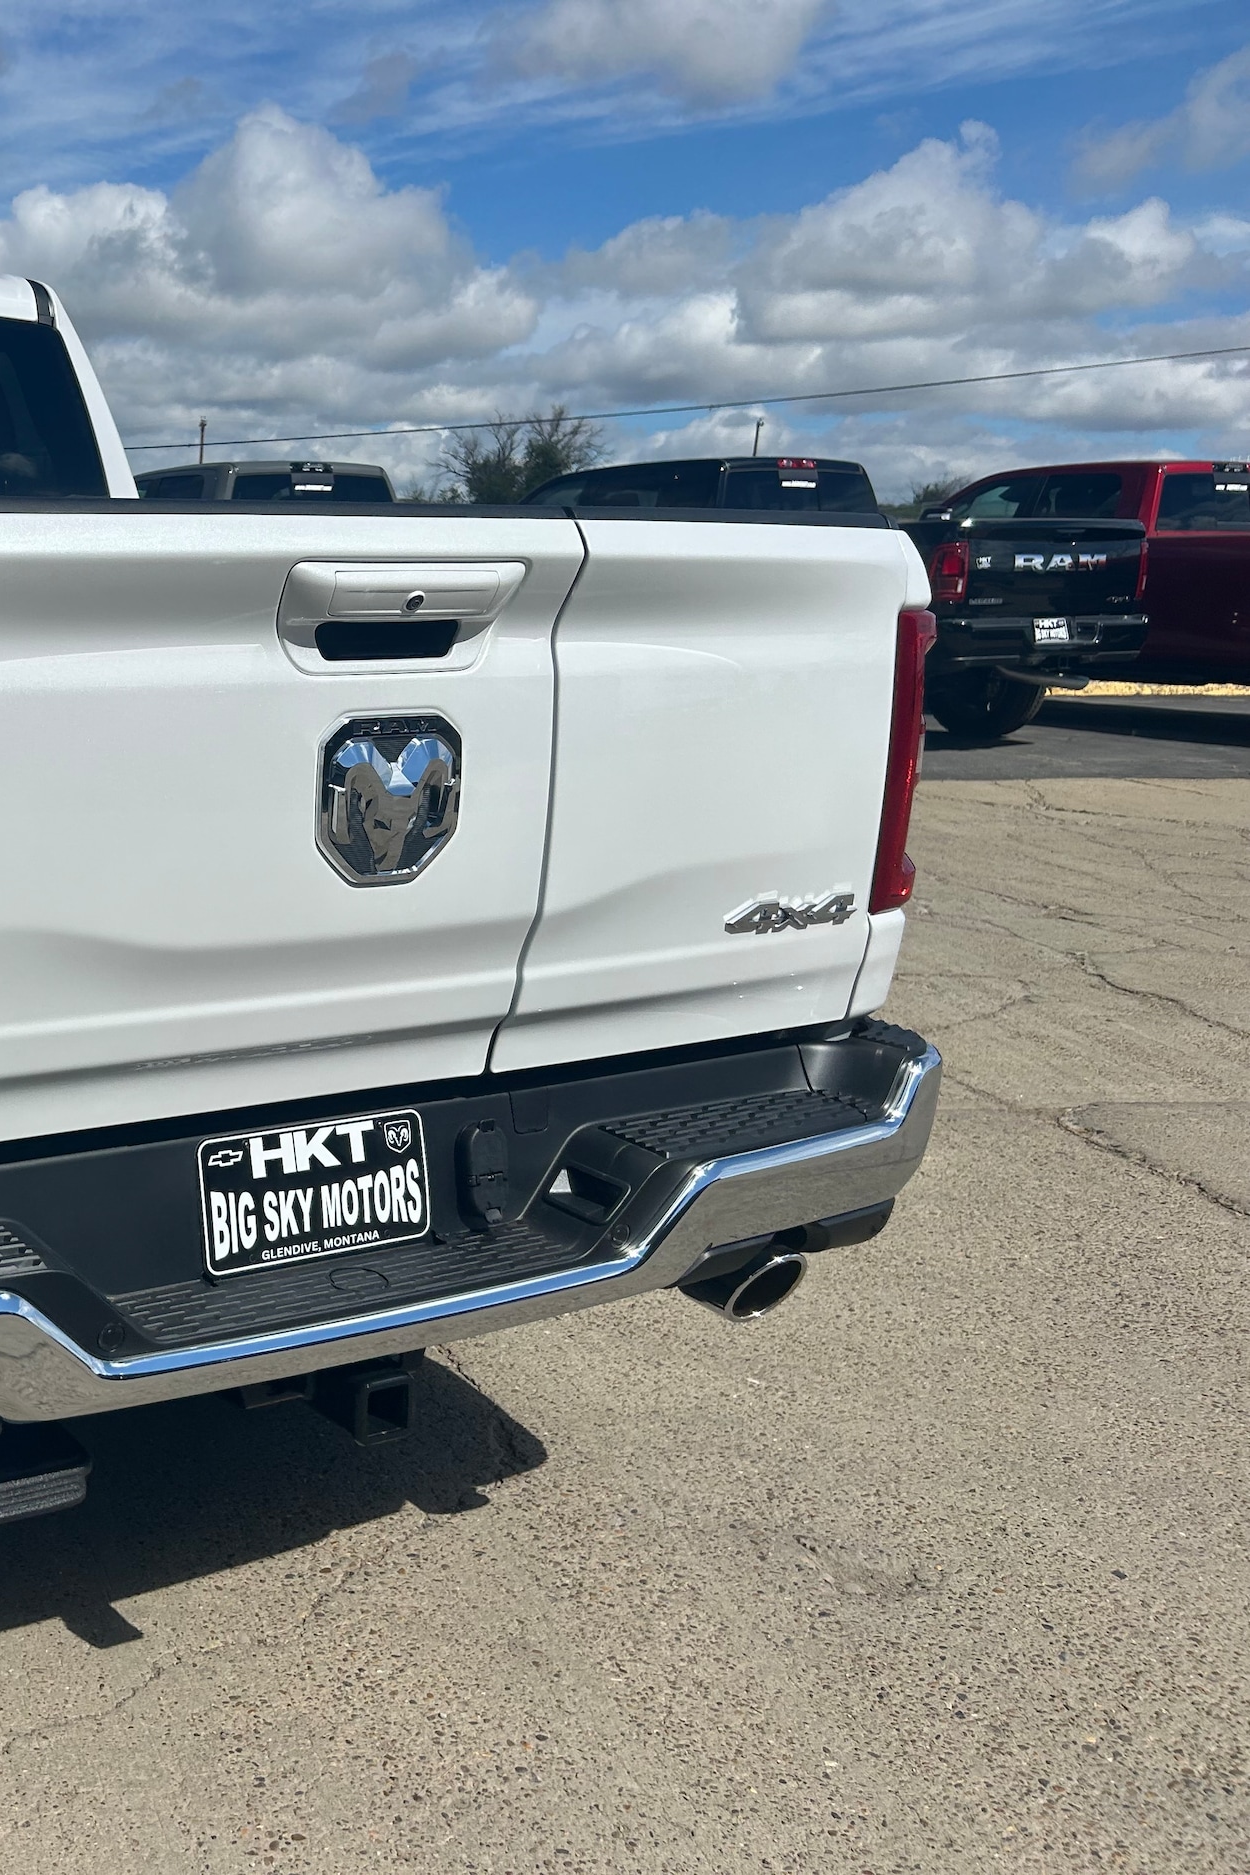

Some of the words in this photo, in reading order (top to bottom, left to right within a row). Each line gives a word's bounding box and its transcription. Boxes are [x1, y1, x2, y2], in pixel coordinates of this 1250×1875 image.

[1014, 553, 1107, 571] RAM
[353, 719, 438, 735] RAM
[724, 892, 857, 935] 4x4
[249, 1120, 374, 1180] HKT
[210, 1190, 258, 1261] BIG
[263, 1187, 314, 1242] SKY
[320, 1158, 422, 1229] MOTORS
[261, 1240, 322, 1261] GLENDIVE,
[324, 1229, 380, 1249] MONTANA
